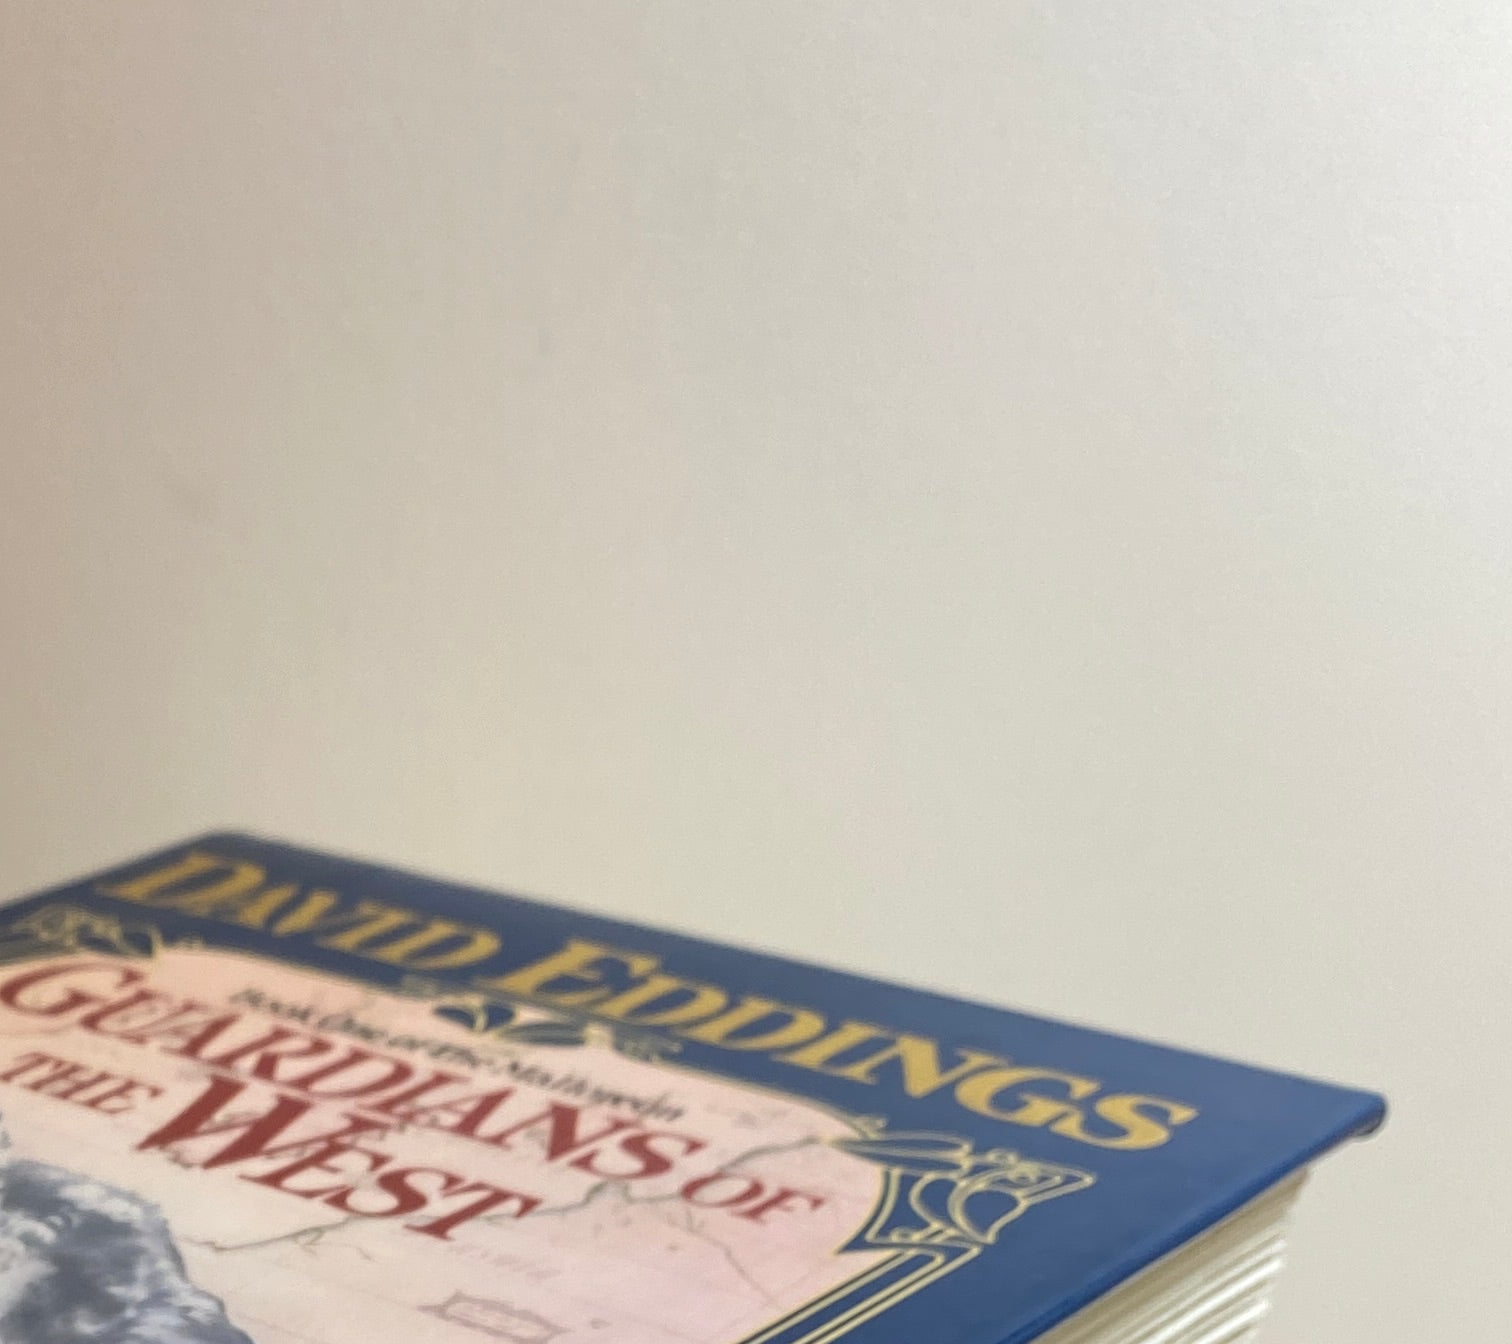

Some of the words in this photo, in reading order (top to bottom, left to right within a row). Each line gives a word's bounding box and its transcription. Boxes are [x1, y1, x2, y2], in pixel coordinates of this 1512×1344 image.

[95, 853, 502, 970] DAVID
[489, 939, 1199, 1151] EDDINGS
[134, 1074, 545, 1241] WEST
[678, 1173, 826, 1226] OF
